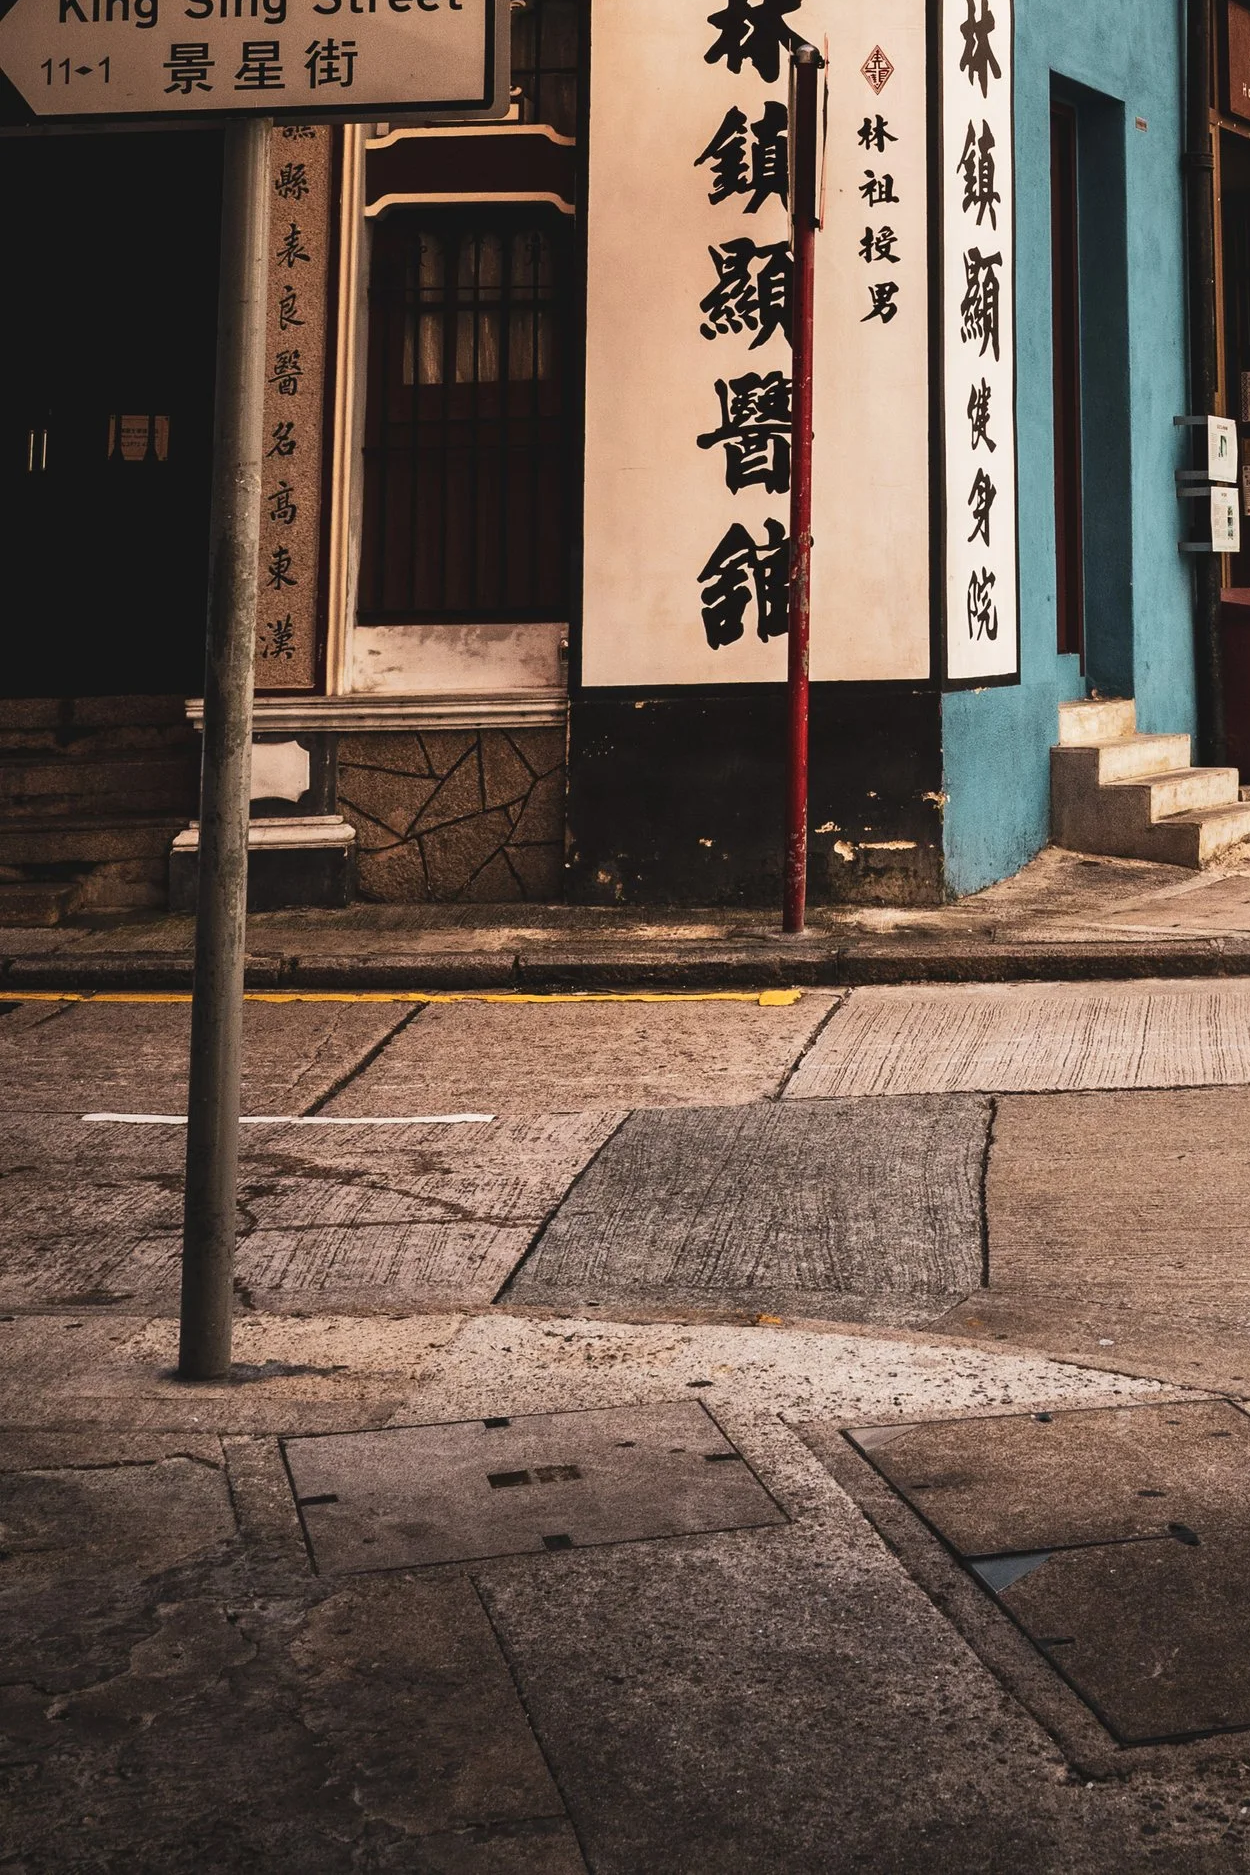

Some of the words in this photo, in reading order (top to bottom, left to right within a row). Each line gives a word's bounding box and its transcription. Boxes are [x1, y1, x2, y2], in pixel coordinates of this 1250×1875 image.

[162, 37, 358, 95] 景星街
[856, 114, 901, 324] 林祖授男
